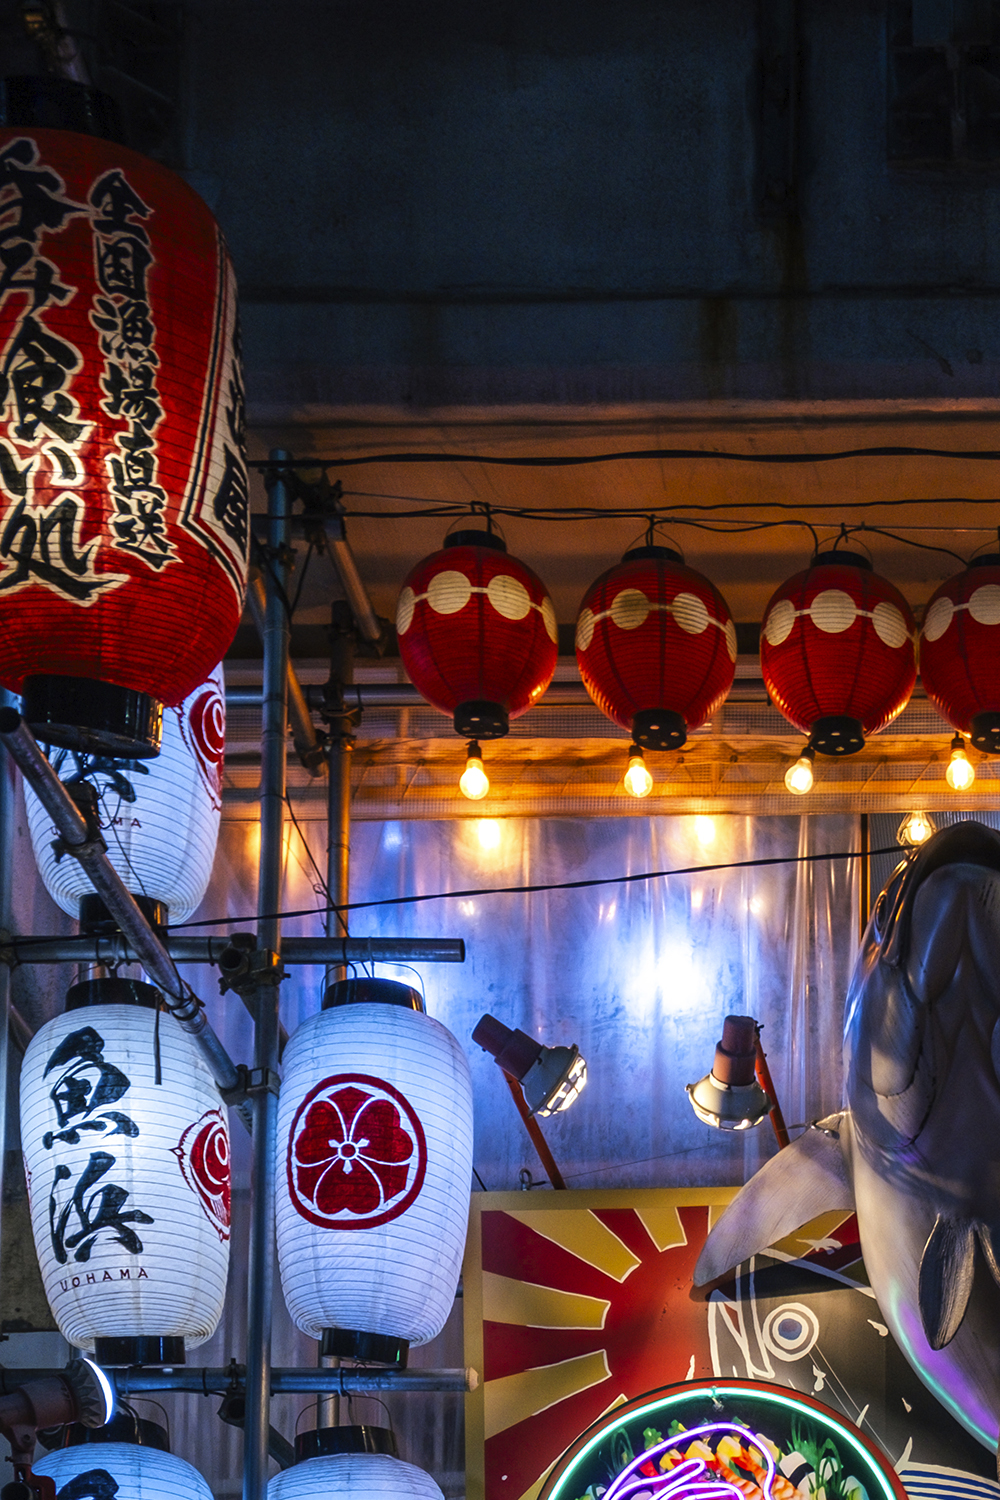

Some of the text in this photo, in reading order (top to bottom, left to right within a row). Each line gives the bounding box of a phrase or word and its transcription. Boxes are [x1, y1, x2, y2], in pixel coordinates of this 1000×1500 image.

[88, 167, 182, 571] 全国漁場直送
[43, 1025, 154, 1265] 魚浜
[60, 1267, 148, 1292] UOHAMA
